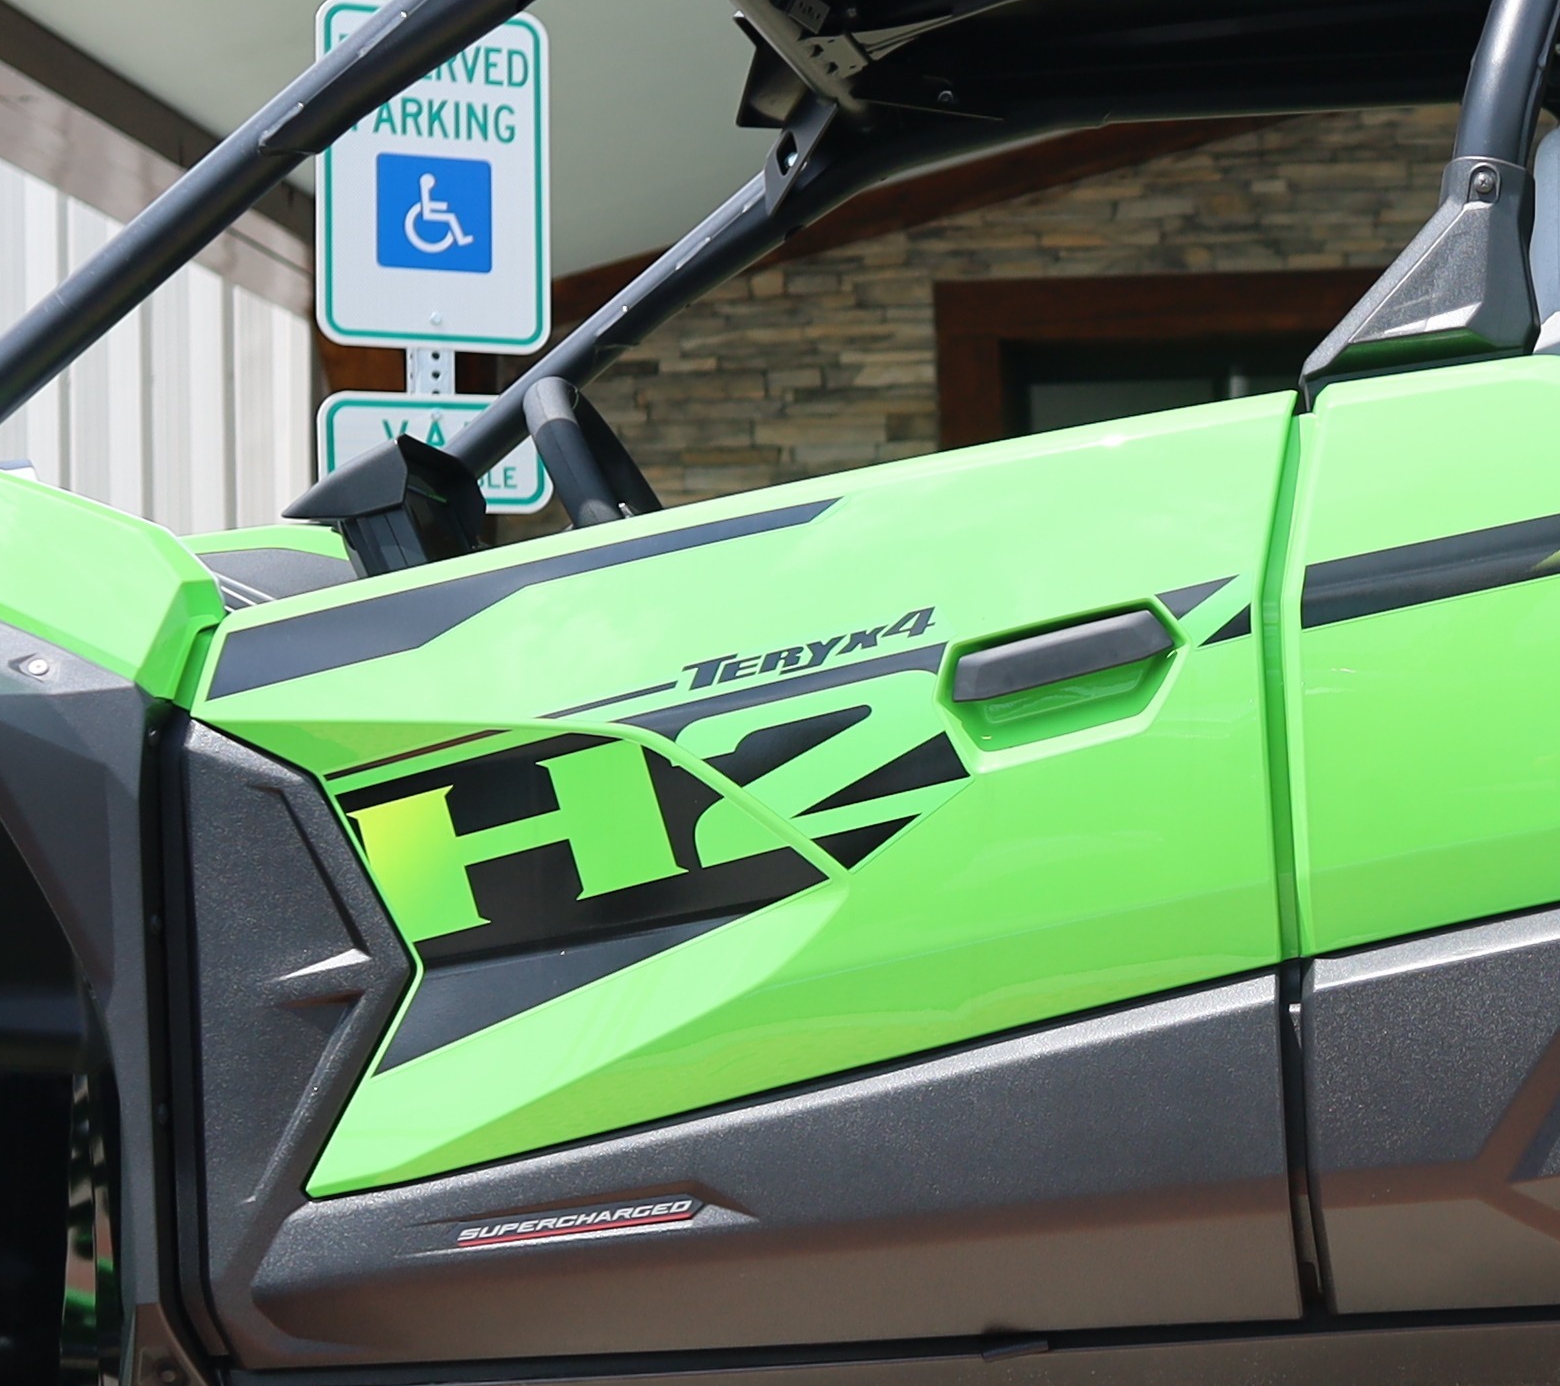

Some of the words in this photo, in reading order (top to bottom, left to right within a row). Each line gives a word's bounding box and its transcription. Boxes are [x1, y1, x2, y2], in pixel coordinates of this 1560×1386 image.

[351, 96, 516, 144] ARKING
[349, 668, 976, 942] H2
[456, 1198, 694, 1243] SUPERCHARGED
